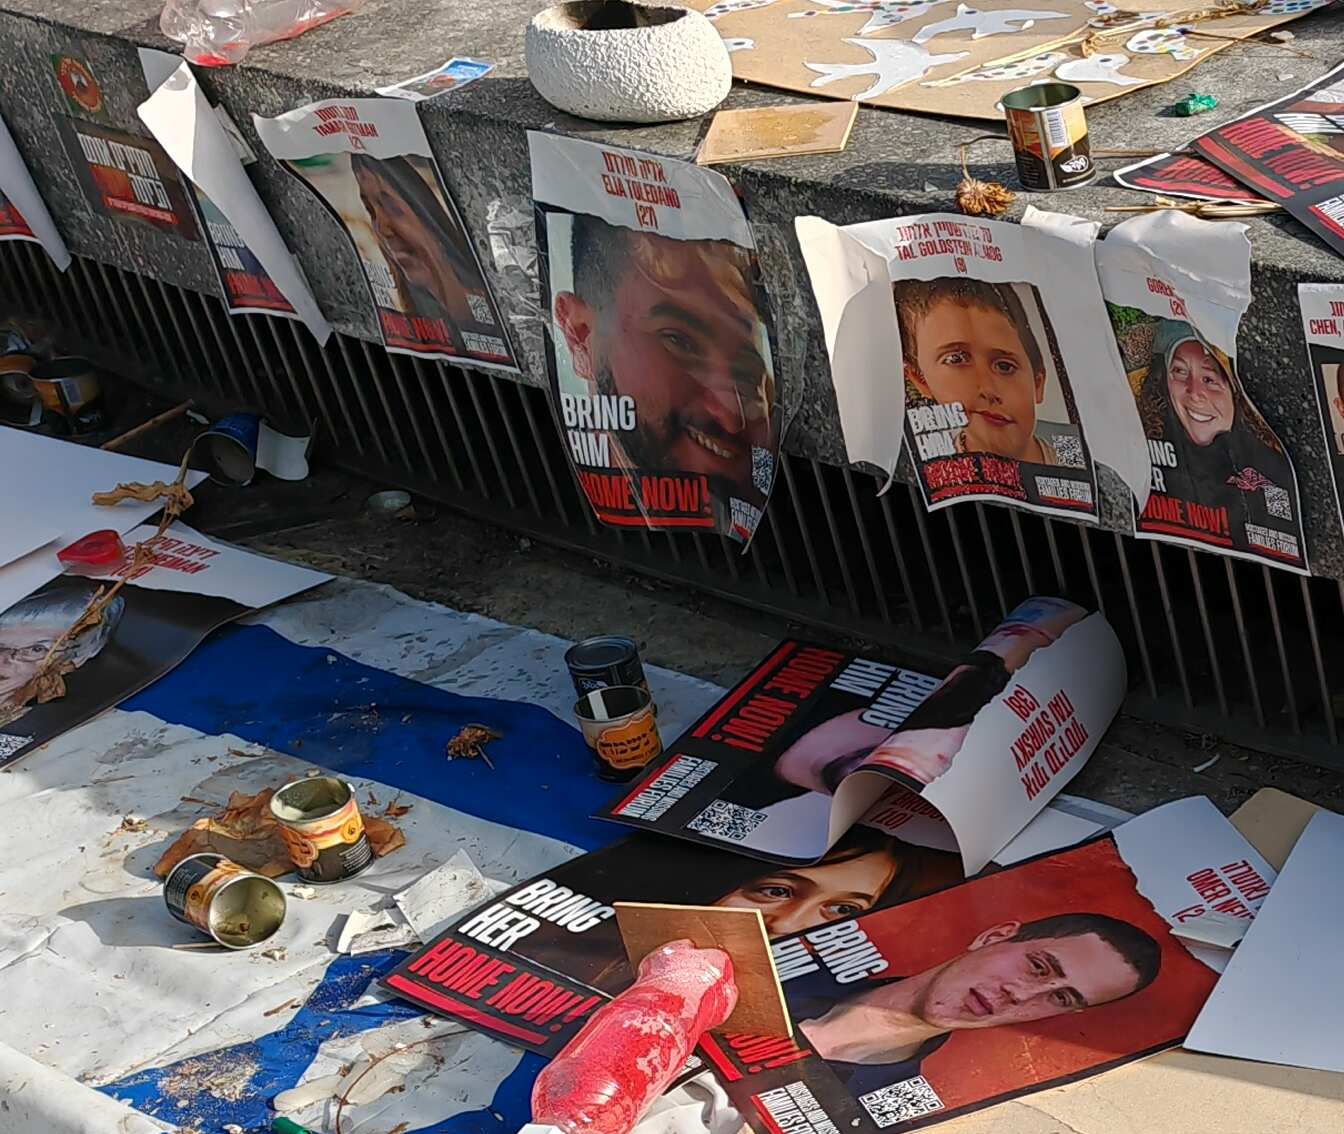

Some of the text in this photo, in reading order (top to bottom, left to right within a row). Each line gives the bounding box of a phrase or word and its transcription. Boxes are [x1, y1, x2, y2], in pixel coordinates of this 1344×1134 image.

[1219, 117, 1300, 160] HOME
[602, 174, 682, 210] ELIA TOLEDANO
[1309, 318, 1342, 337] CHEN,
[560, 394, 637, 432] BRING
[568, 432, 612, 468] HIM
[641, 476, 712, 514] NOW!
[1187, 500, 1230, 535] NOW!
[829, 657, 898, 699] HIM
[859, 667, 945, 730] BRING
[709, 646, 845, 753] HOME NOW!
[1002, 683, 1040, 723] (38)
[1009, 688, 1075, 773] ITAI SVIRSKY
[1020, 760, 1050, 801] איתי
[618, 786, 666, 818] FORUM
[505, 878, 617, 934] BRING
[457, 902, 541, 953] HER
[805, 919, 889, 984] BRING
[407, 937, 601, 1033] HOME NOW!
[758, 1087, 809, 1130] FAMILIES
